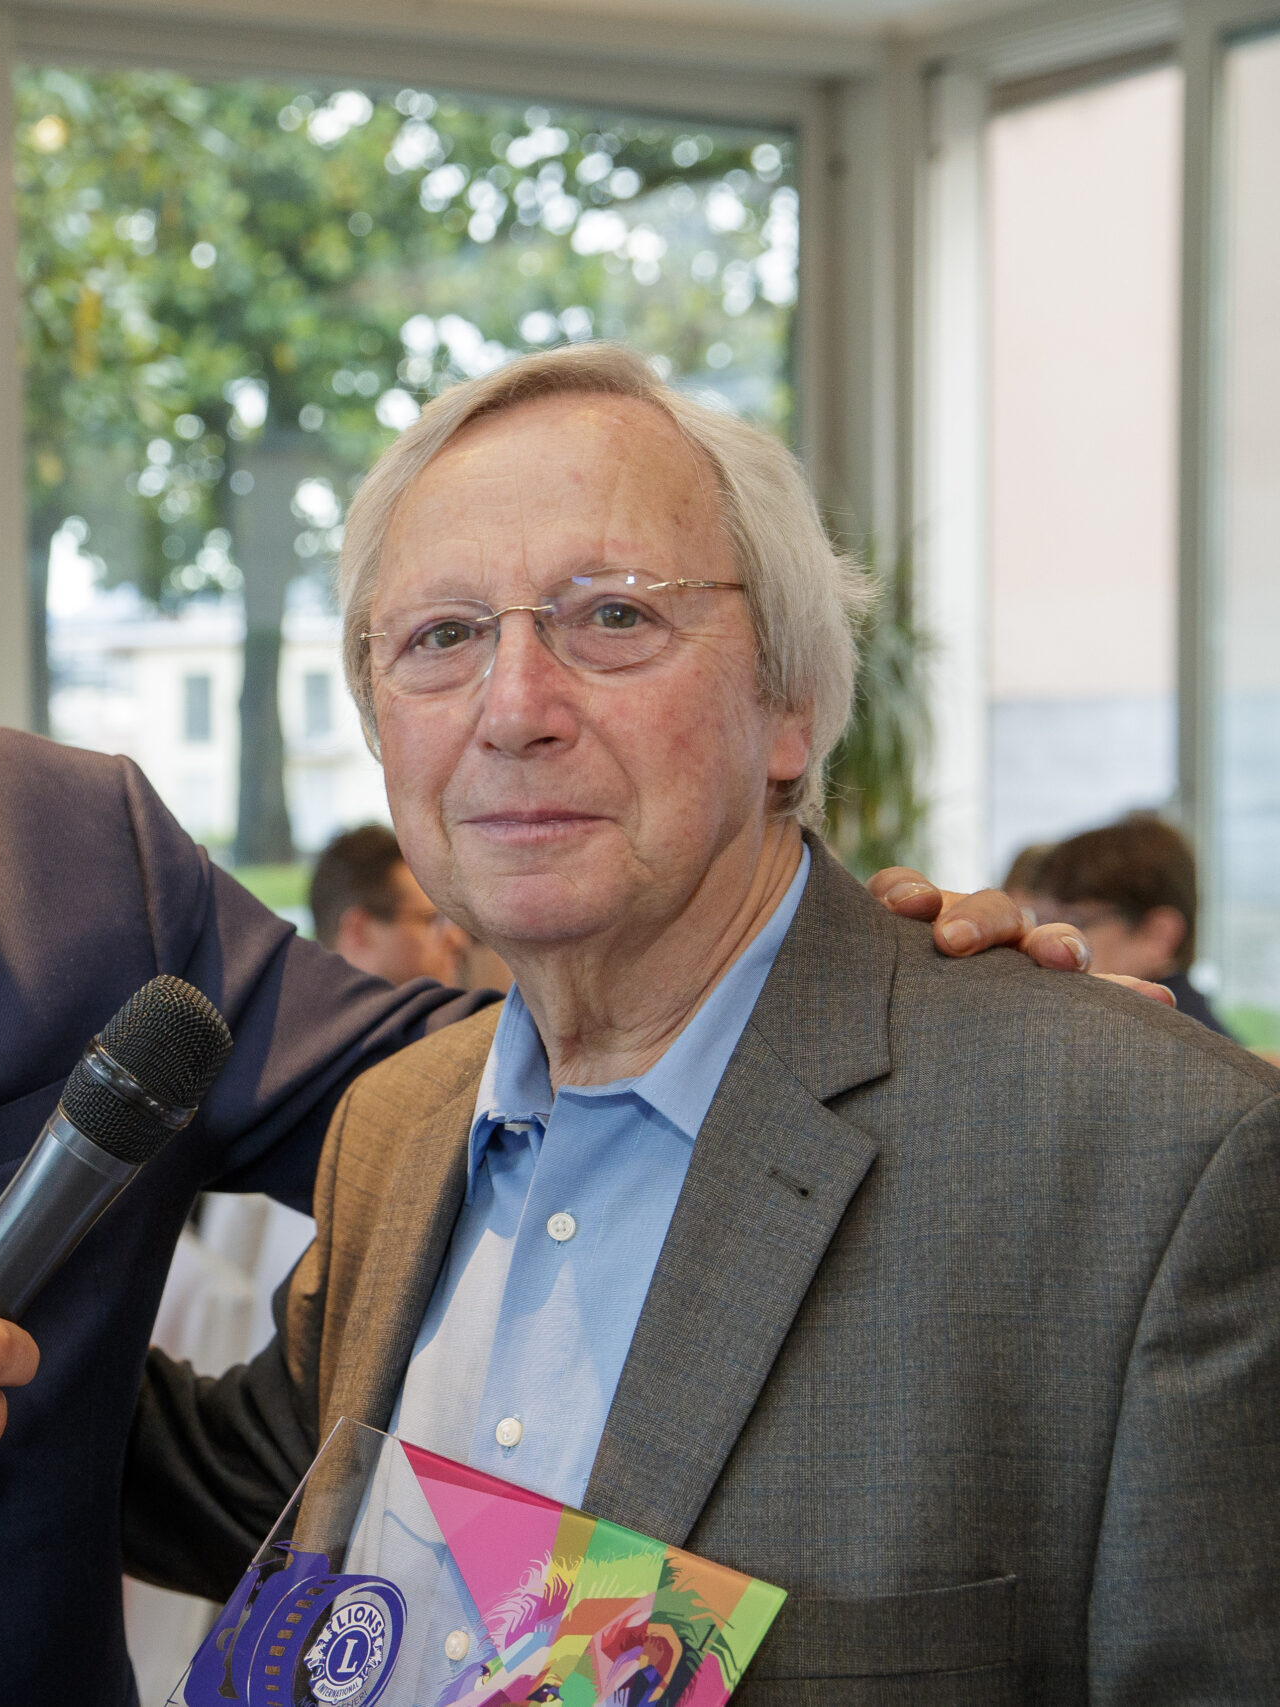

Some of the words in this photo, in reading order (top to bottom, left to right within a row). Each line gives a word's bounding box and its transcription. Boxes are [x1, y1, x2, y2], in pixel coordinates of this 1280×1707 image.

[336, 1607, 383, 1634] LIONS
[336, 1638, 358, 1673] L
[317, 1682, 360, 1698] INTERNATIONAL
